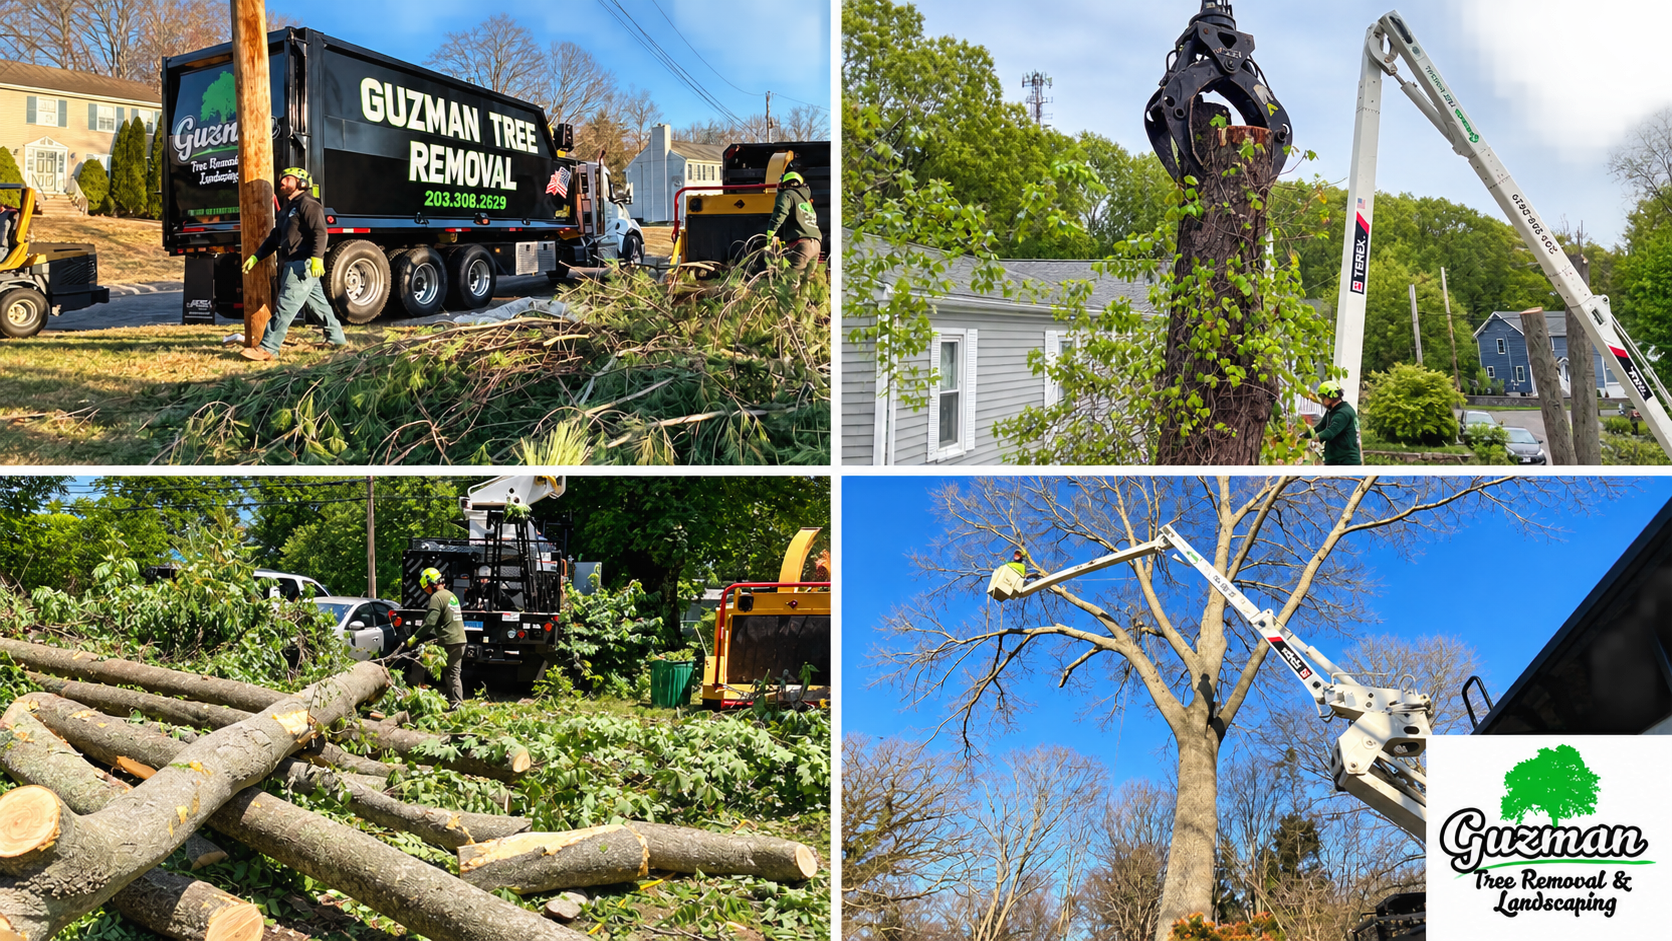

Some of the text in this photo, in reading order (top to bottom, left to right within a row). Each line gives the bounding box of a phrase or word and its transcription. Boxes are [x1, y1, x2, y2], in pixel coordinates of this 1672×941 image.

[360, 77, 539, 154] GUZMAN TREE
[408, 140, 517, 191] REMOVAL
[424, 190, 507, 210] 203.308.2629
[1353, 238, 1366, 278] TEREX
